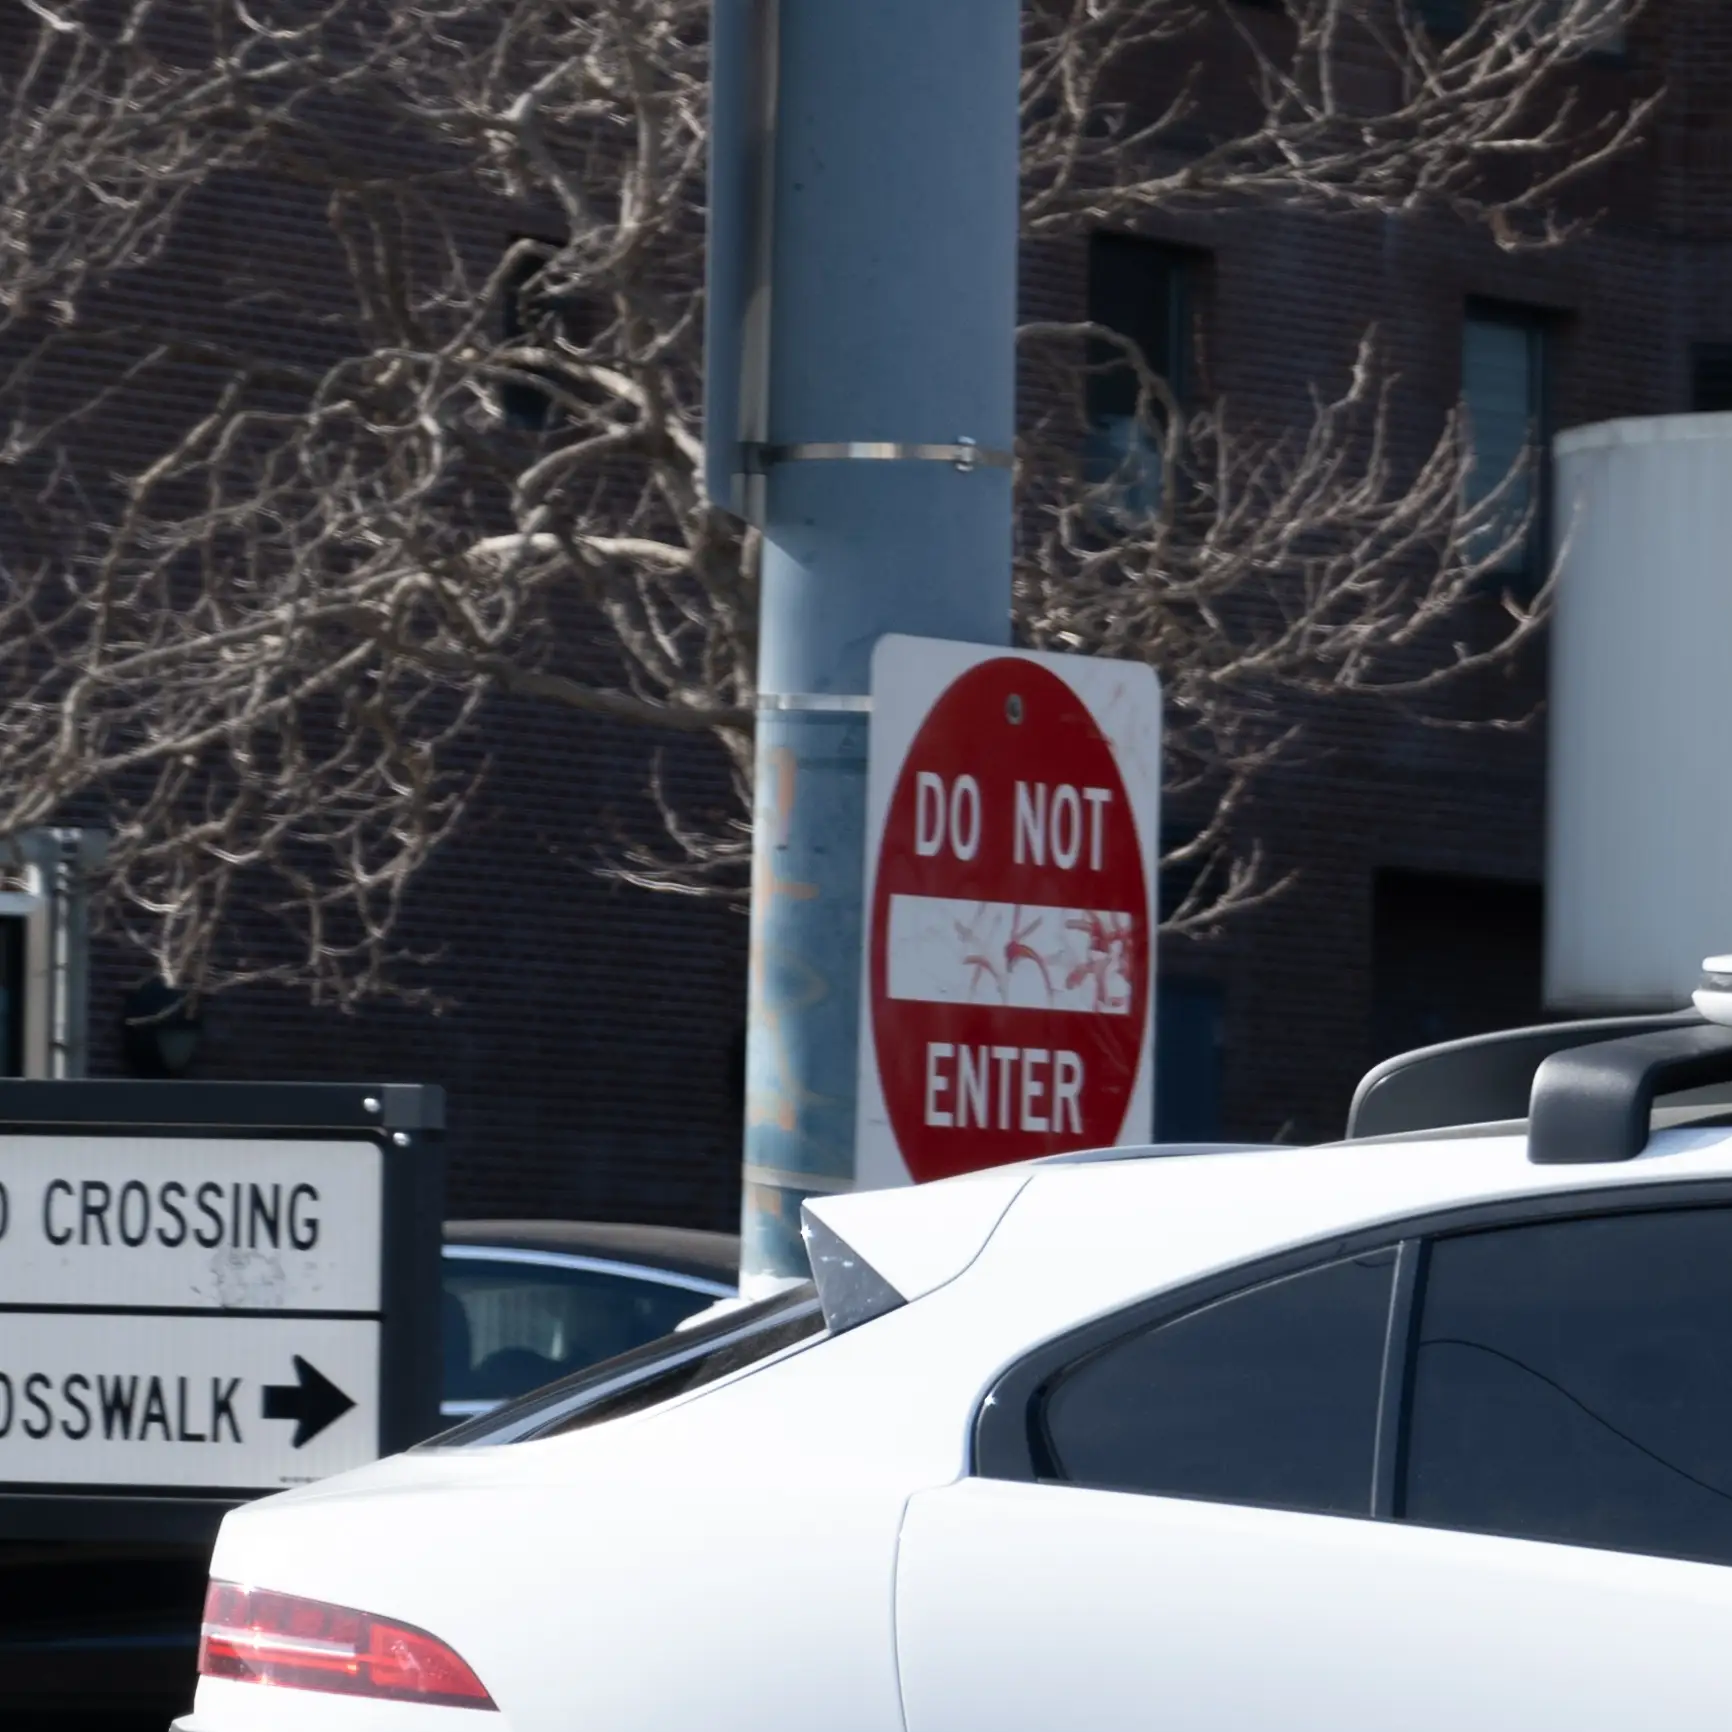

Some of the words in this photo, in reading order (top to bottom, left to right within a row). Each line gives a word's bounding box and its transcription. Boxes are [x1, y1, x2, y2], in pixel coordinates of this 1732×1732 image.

[915, 771, 983, 861] DO
[1013, 780, 1113, 871] NOT
[924, 1040, 1085, 1135] ENTER
[44, 1178, 320, 1251] CROSSING
